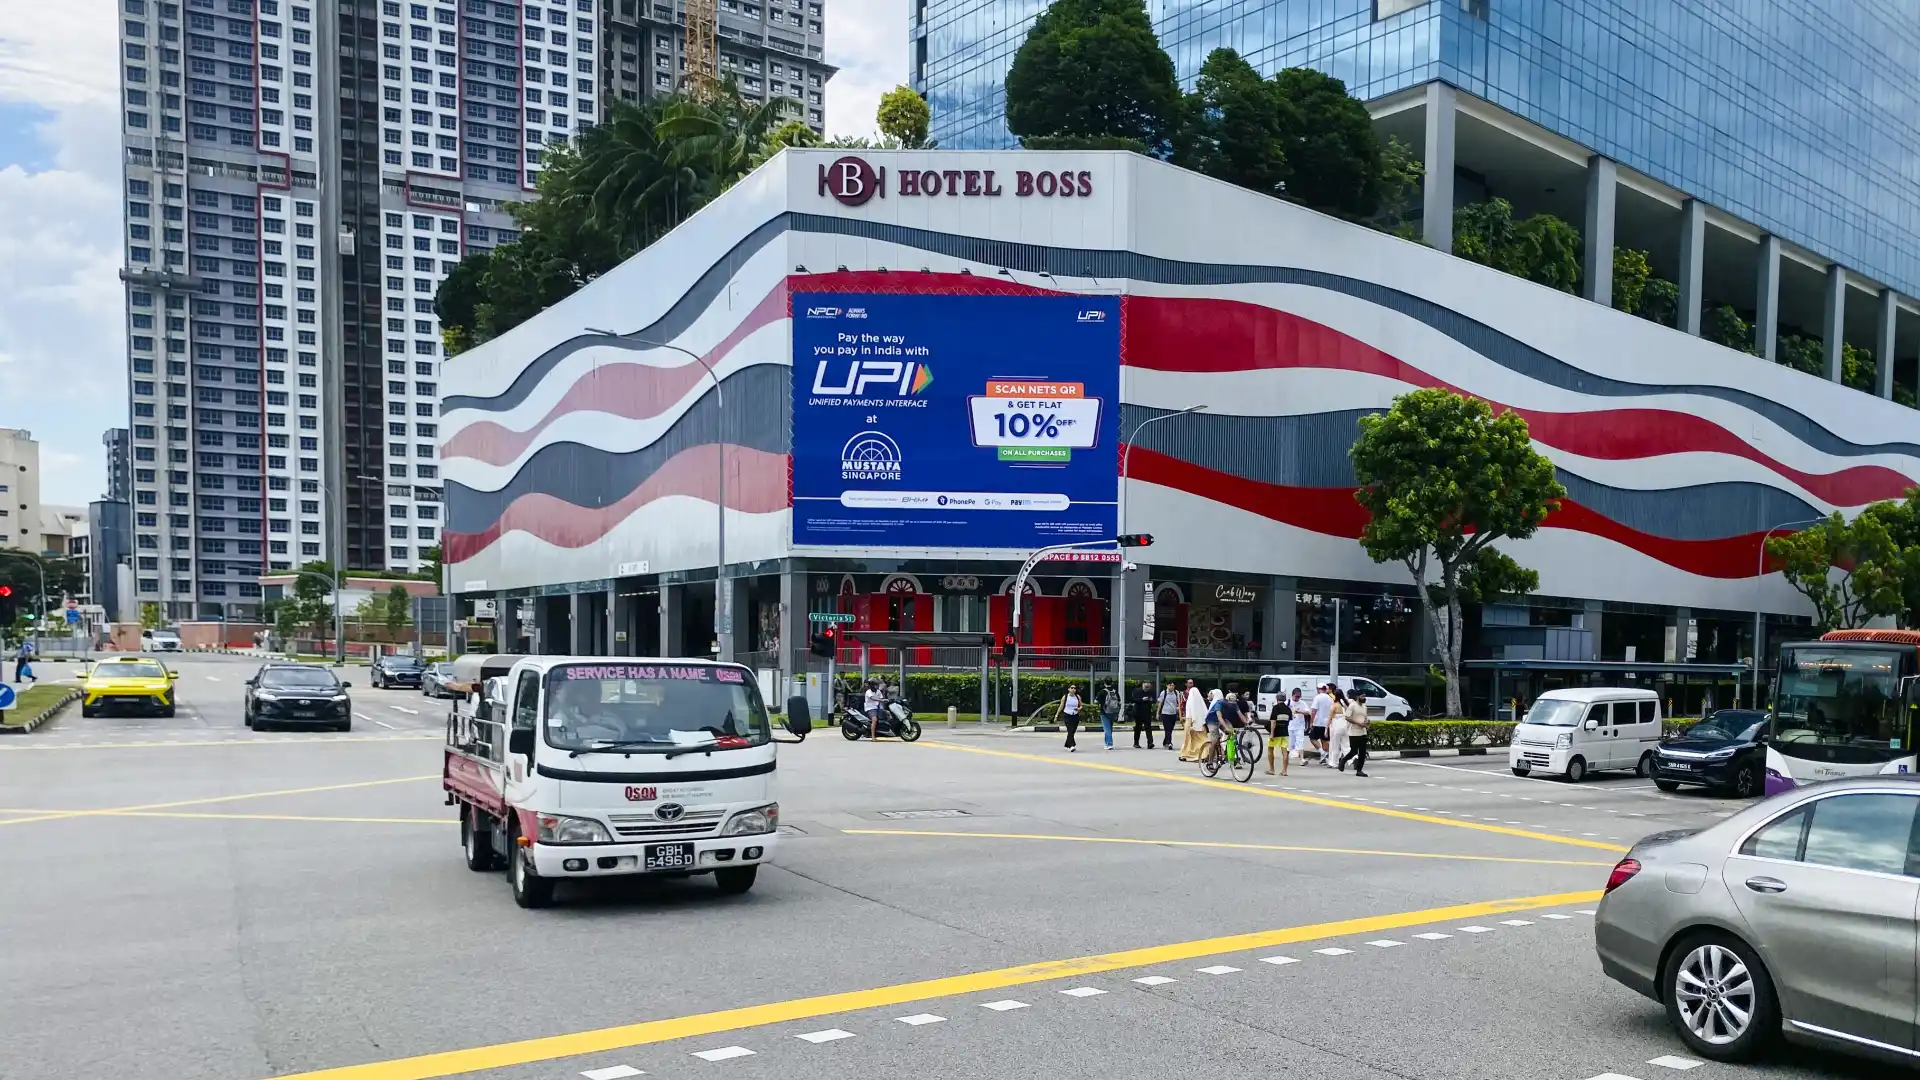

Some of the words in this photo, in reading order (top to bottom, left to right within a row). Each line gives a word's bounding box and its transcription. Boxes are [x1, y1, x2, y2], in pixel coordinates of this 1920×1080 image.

[899, 170, 1001, 196] HOTEL
[1016, 171, 1092, 196] BOSS
[807, 307, 838, 316] NPCI
[1078, 311, 1102, 320] UPI
[838, 333, 858, 343] Pay
[862, 334, 879, 342] the
[883, 335, 905, 344] way
[814, 346, 834, 355] you
[838, 346, 858, 356] pay
[862, 346, 871, 355] in
[875, 346, 901, 355] India
[905, 346, 929, 355] with
[812, 360, 915, 395] UPI
[995, 385, 1025, 394] SCAN
[1029, 386, 1056, 394] NETS
[1060, 386, 1076, 395] QR
[808, 398, 841, 406] UNIFIED
[843, 398, 884, 407] PAYMENTS
[886, 399, 928, 407] INTERFACE
[866, 414, 877, 423] at
[994, 413, 1058, 438] 10%
[842, 461, 901, 470] MUSTAFA
[842, 472, 901, 480] SINGAPORE
[566, 667, 625, 680] SERVICE
[627, 667, 655, 680] HAS
[658, 668, 668, 679] A
[671, 668, 709, 680] NAME.
[656, 845, 683, 856] GBH
